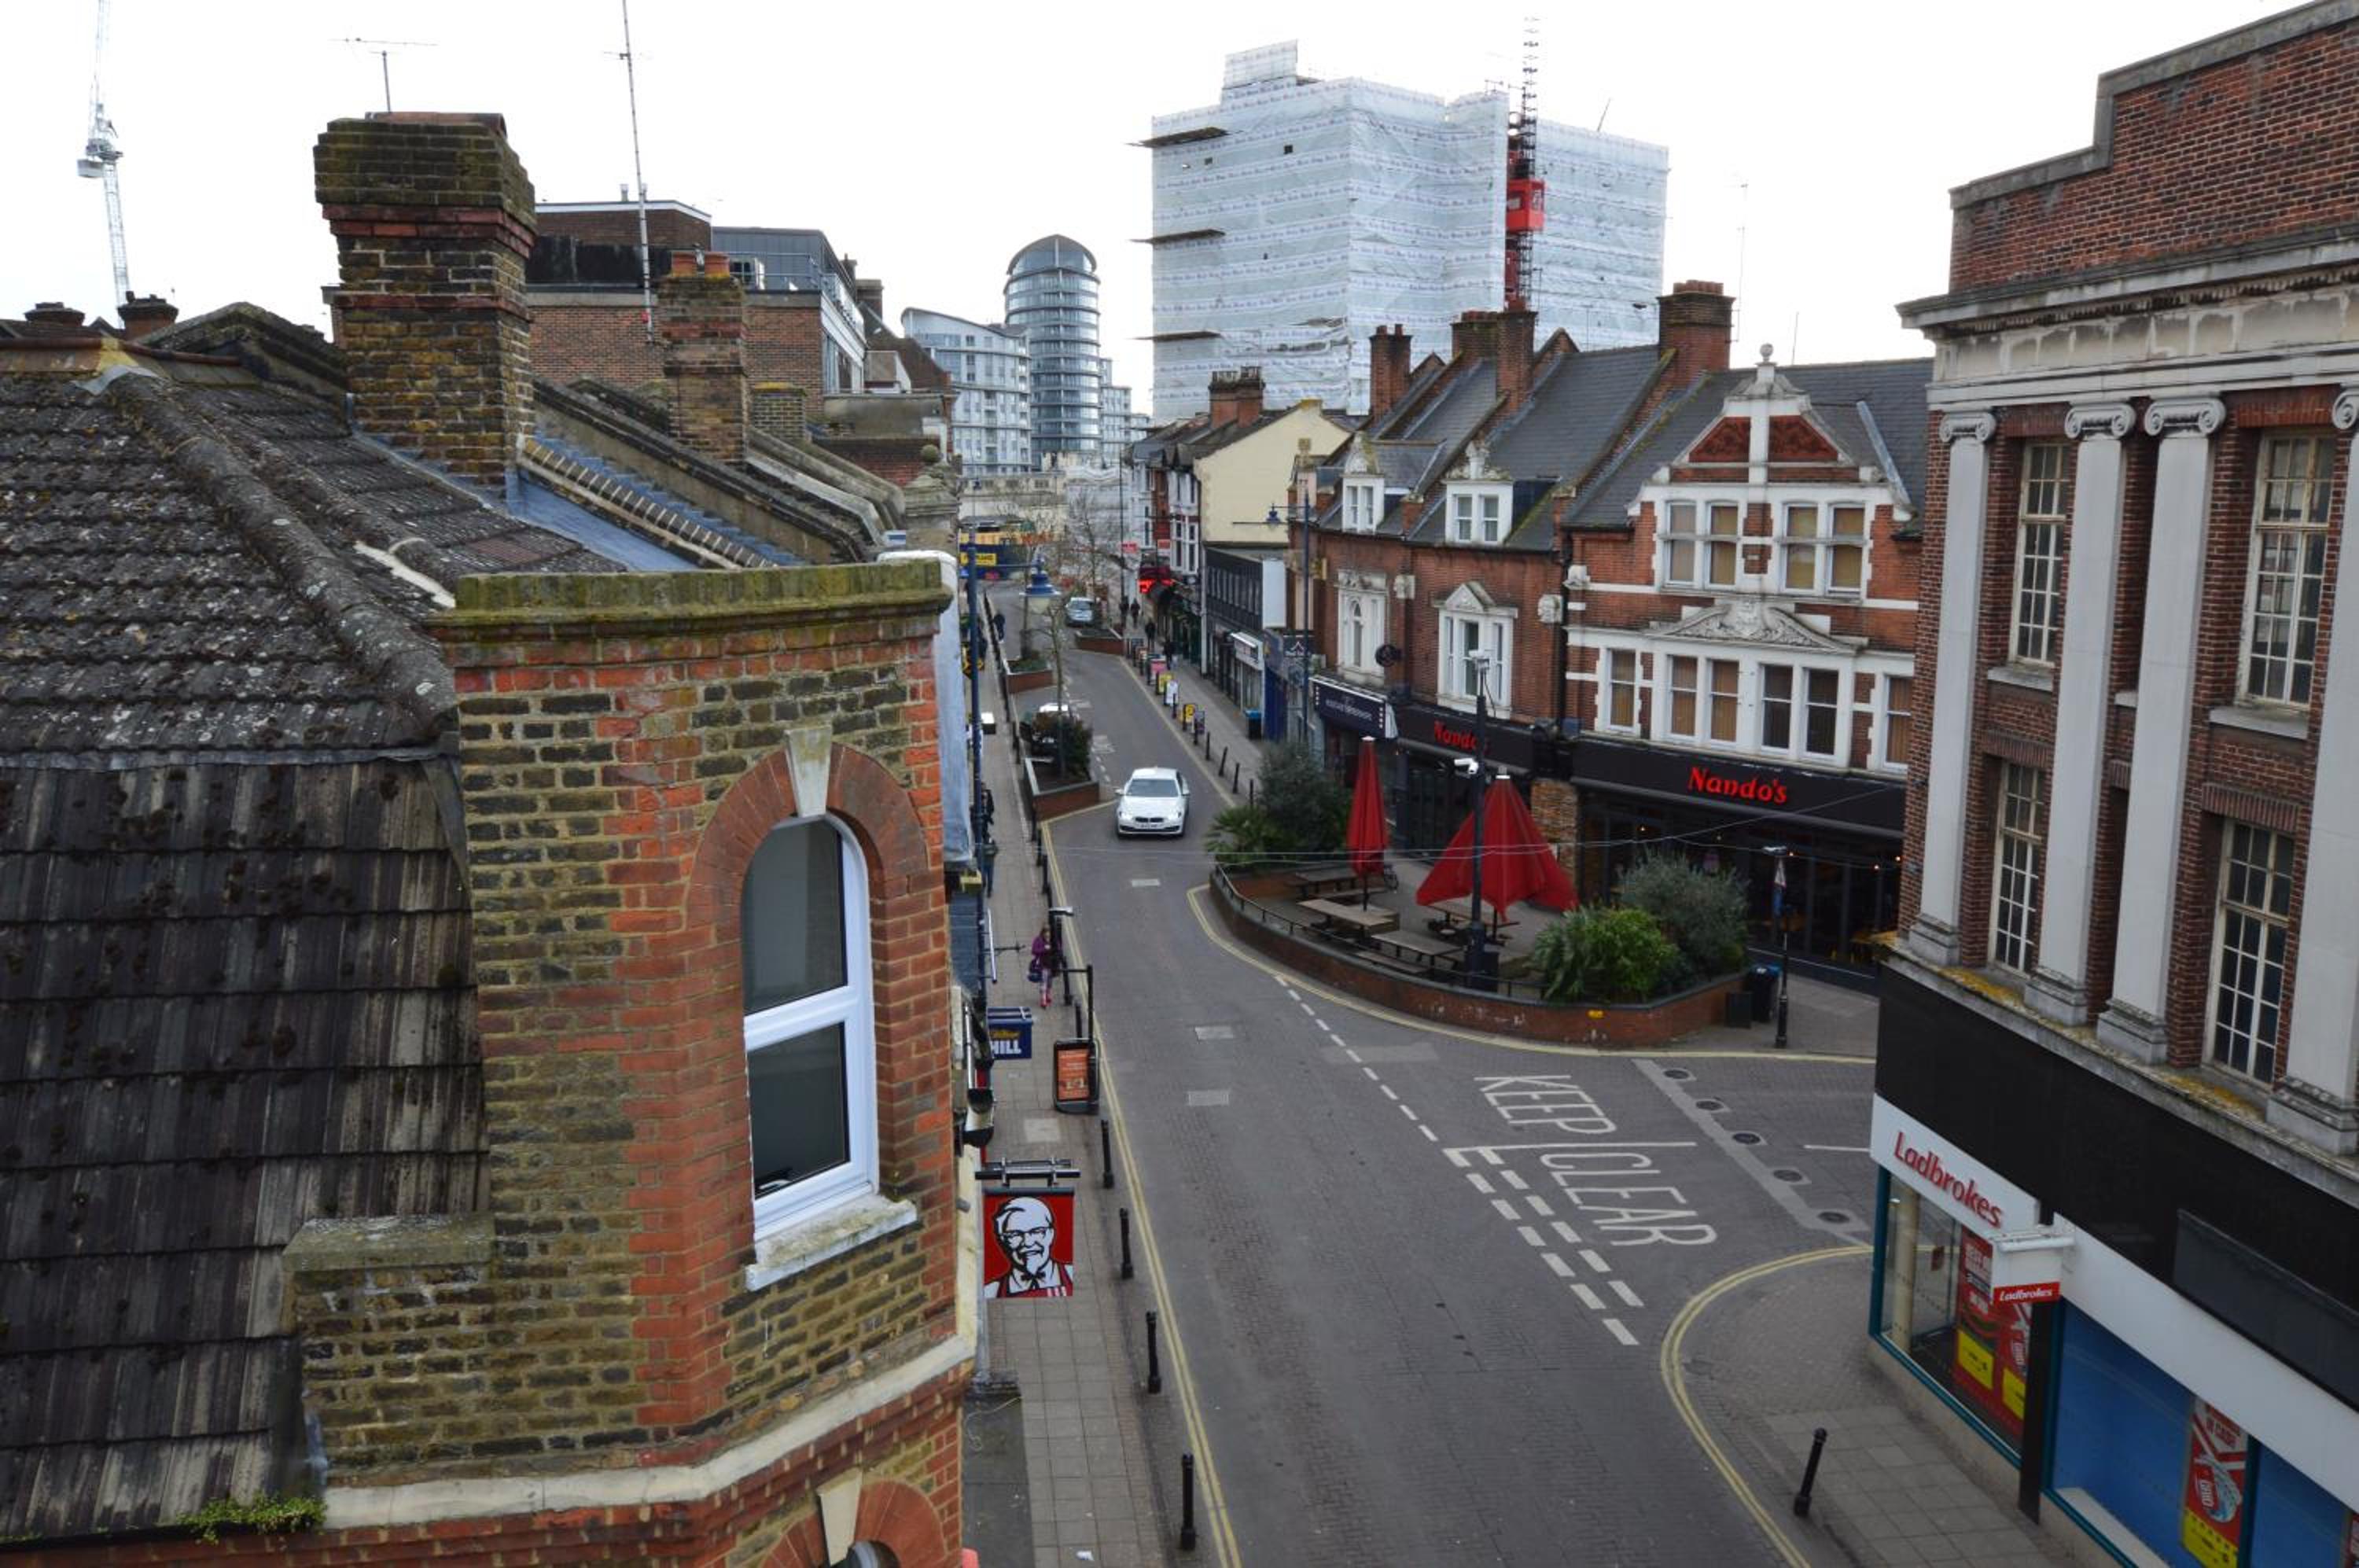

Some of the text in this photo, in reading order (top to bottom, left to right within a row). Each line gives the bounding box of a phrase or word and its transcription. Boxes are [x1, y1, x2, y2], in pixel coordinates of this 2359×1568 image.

[1687, 767, 1787, 805] Nando's
[1474, 1075, 1617, 1134] KEEP
[1540, 1152, 1718, 1246] CLEAR
[1893, 1131, 2003, 1229] Ladbrokes
[2000, 1287, 2053, 1302] Ladbrokes
